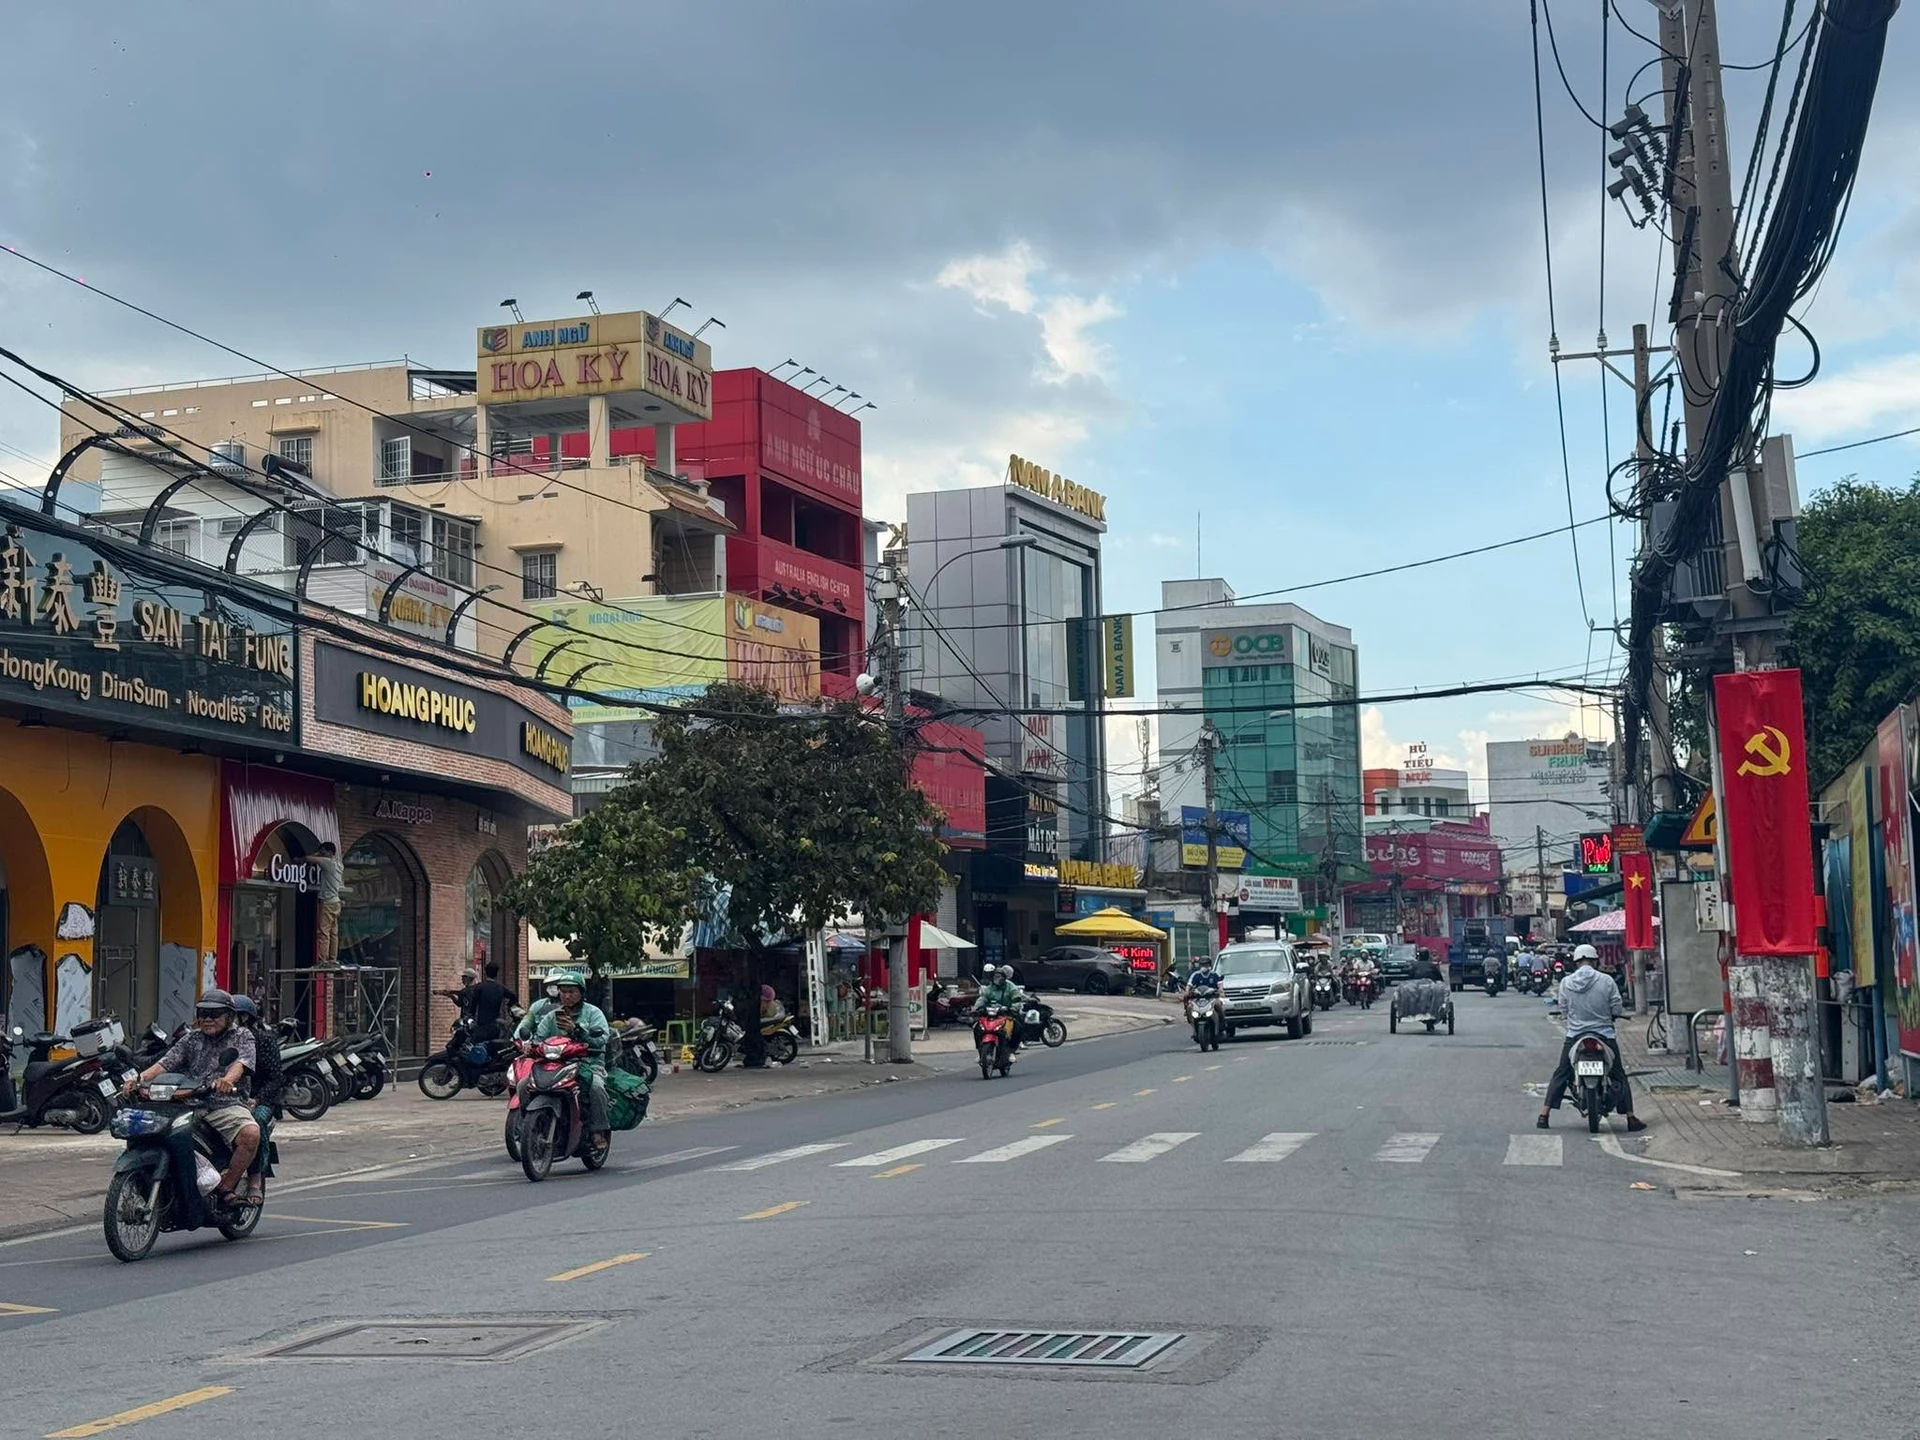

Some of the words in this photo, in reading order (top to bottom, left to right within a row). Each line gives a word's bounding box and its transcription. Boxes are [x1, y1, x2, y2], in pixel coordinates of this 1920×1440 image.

[522, 329, 554, 349] ANH
[557, 322, 591, 345] NGỮ
[491, 359, 564, 393] HOA
[576, 343, 630, 384] KỲ
[647, 351, 682, 396] HOA
[686, 369, 708, 407] KỲ
[1010, 453, 1051, 498] NAM
[1051, 473, 1064, 504] A
[1064, 478, 1108, 522] BANK
[775, 560, 806, 583] AUSTRALIA
[806, 570, 829, 590] ENGLISH
[830, 579, 850, 598] CENTER
[140, 600, 183, 648] SAN
[198, 617, 229, 660] TAI
[245, 629, 294, 678] FUNG
[1113, 614, 1123, 651] BANK
[1233, 633, 1284, 654] OCB
[1114, 653, 1123, 662] A
[1114, 665, 1124, 696] NAM
[101, 671, 169, 709] DimSum
[188, 689, 247, 725] Noodles
[262, 704, 291, 733] Rice
[362, 671, 476, 734] HOANGPHUC
[526, 721, 569, 774] HOANGPHUC
[1403, 754, 1434, 768] TIẾU
[1409, 741, 1427, 753] HỦ
[392, 800, 433, 824] Kappa
[271, 853, 307, 893] Gong
[1061, 859, 1092, 885] NAM
[1104, 863, 1139, 888] BANK
